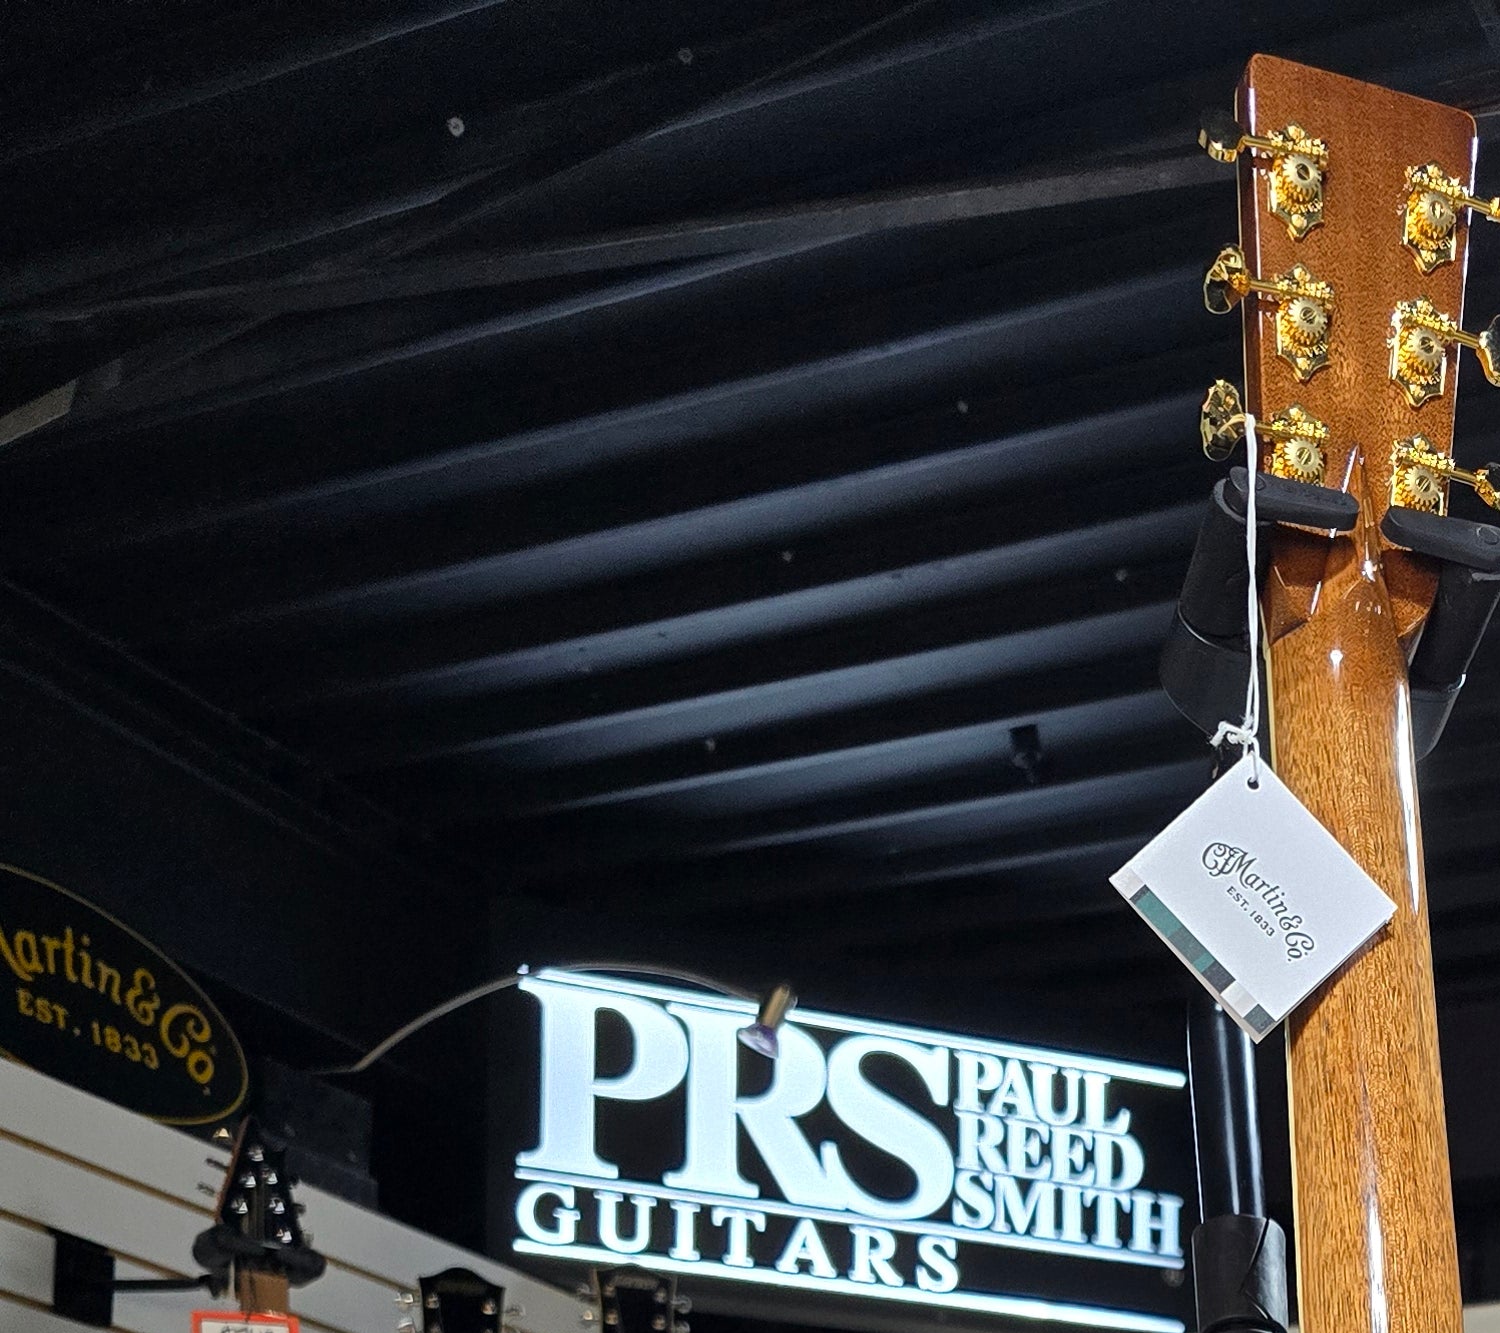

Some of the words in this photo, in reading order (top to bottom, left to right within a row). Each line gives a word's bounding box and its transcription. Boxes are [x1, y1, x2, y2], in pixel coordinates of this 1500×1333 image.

[1227, 886, 1249, 912] EST.
[1249, 910, 1276, 937] 1833
[516, 977, 955, 1220] PRS
[953, 1048, 1131, 1135] PAUL
[953, 1110, 1145, 1191] REED
[515, 1183, 961, 1293] GUITARS
[952, 1169, 1185, 1258] SMITH
